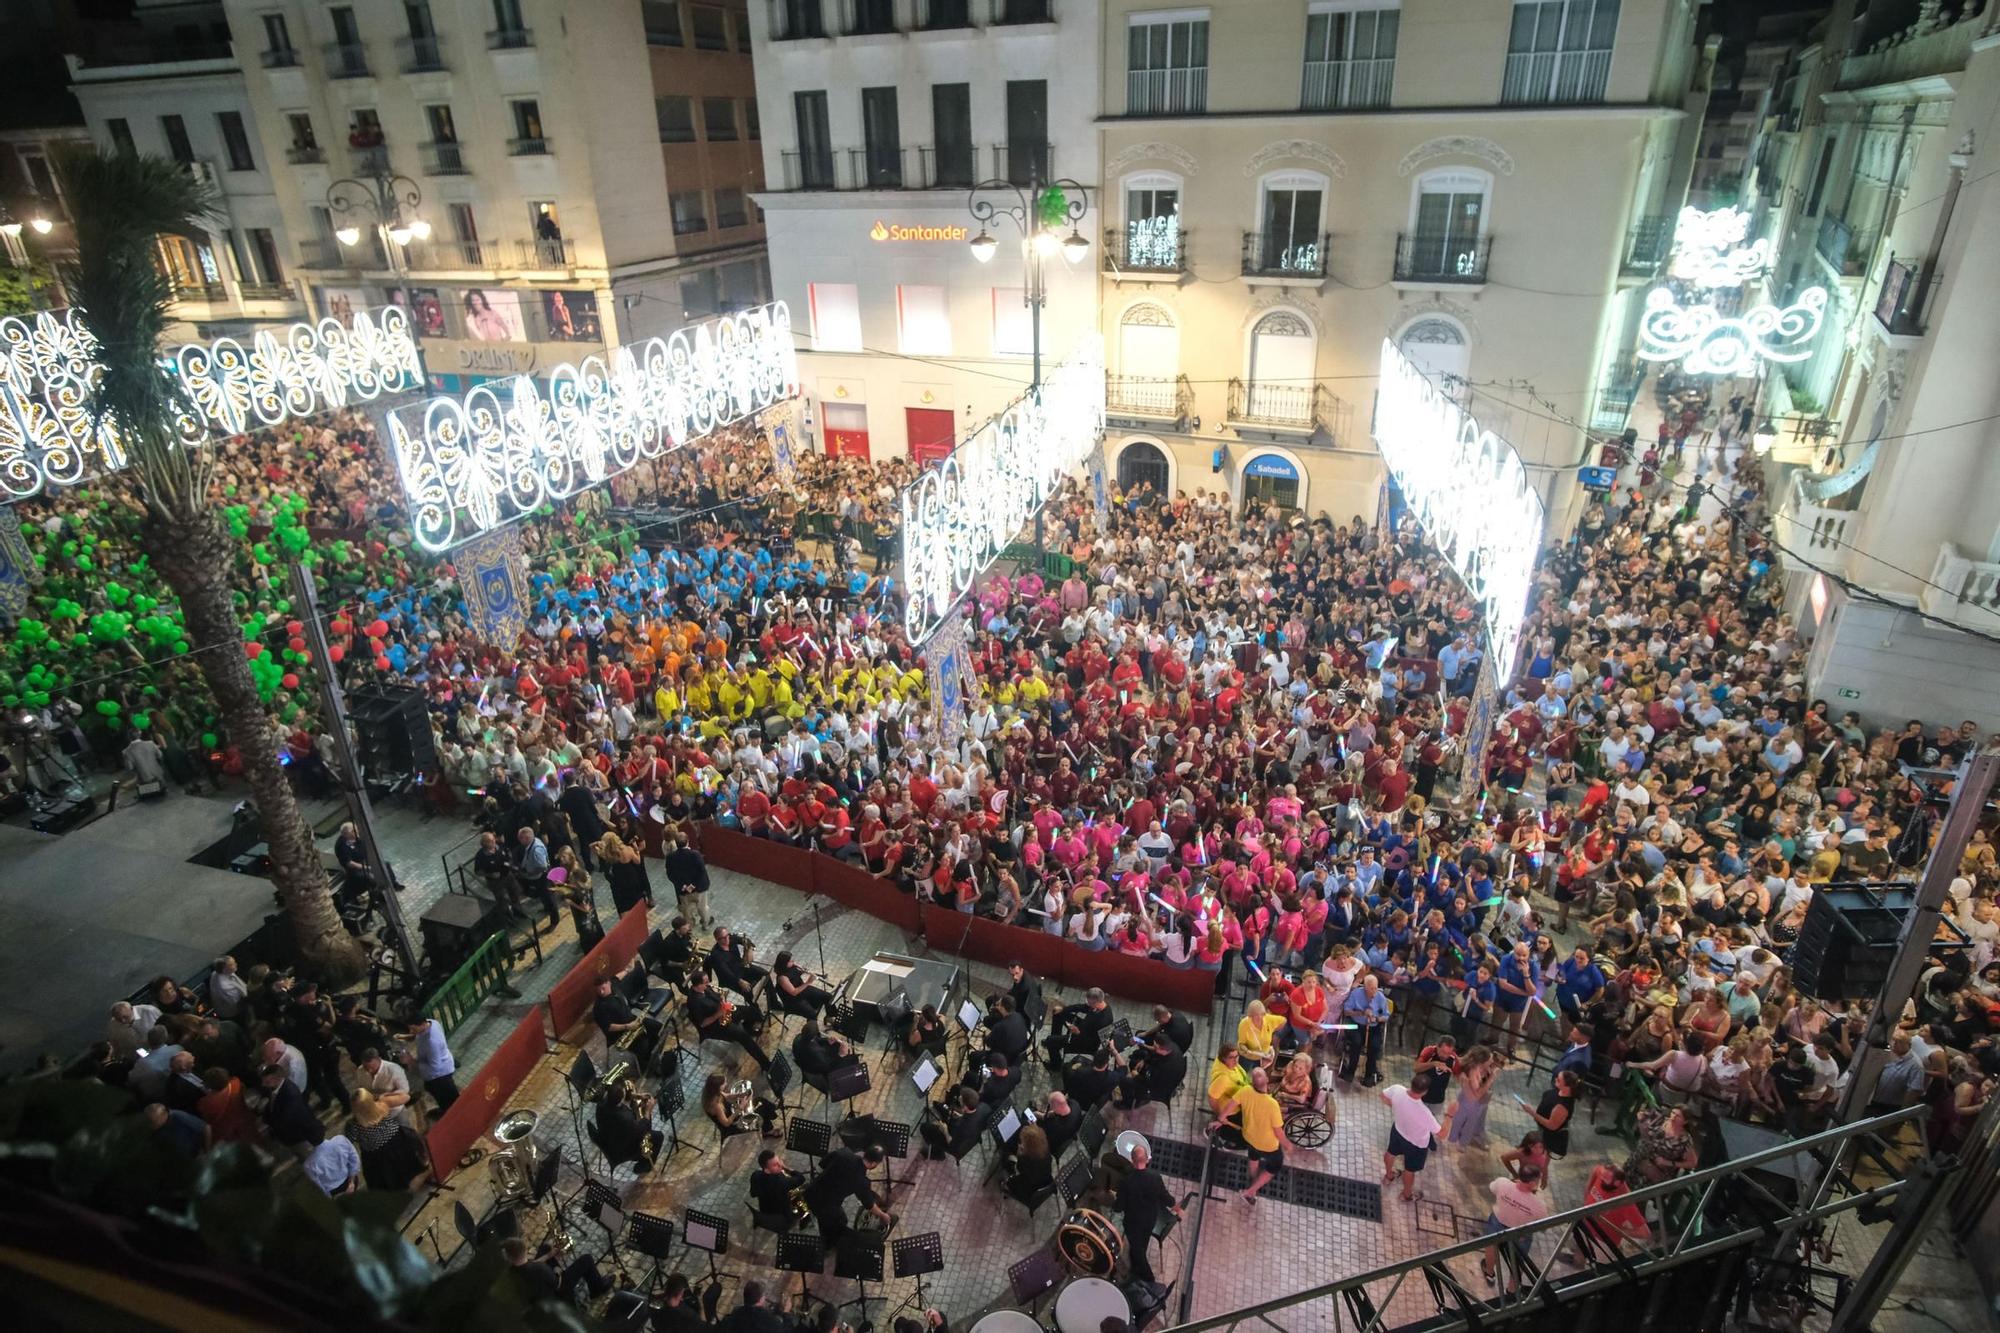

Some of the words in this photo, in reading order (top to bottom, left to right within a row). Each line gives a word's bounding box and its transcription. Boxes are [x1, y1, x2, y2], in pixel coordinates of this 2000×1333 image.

[890, 224, 968, 241] Santander
[1257, 464, 1291, 475] Sabadell
[1600, 471, 1612, 486] S
